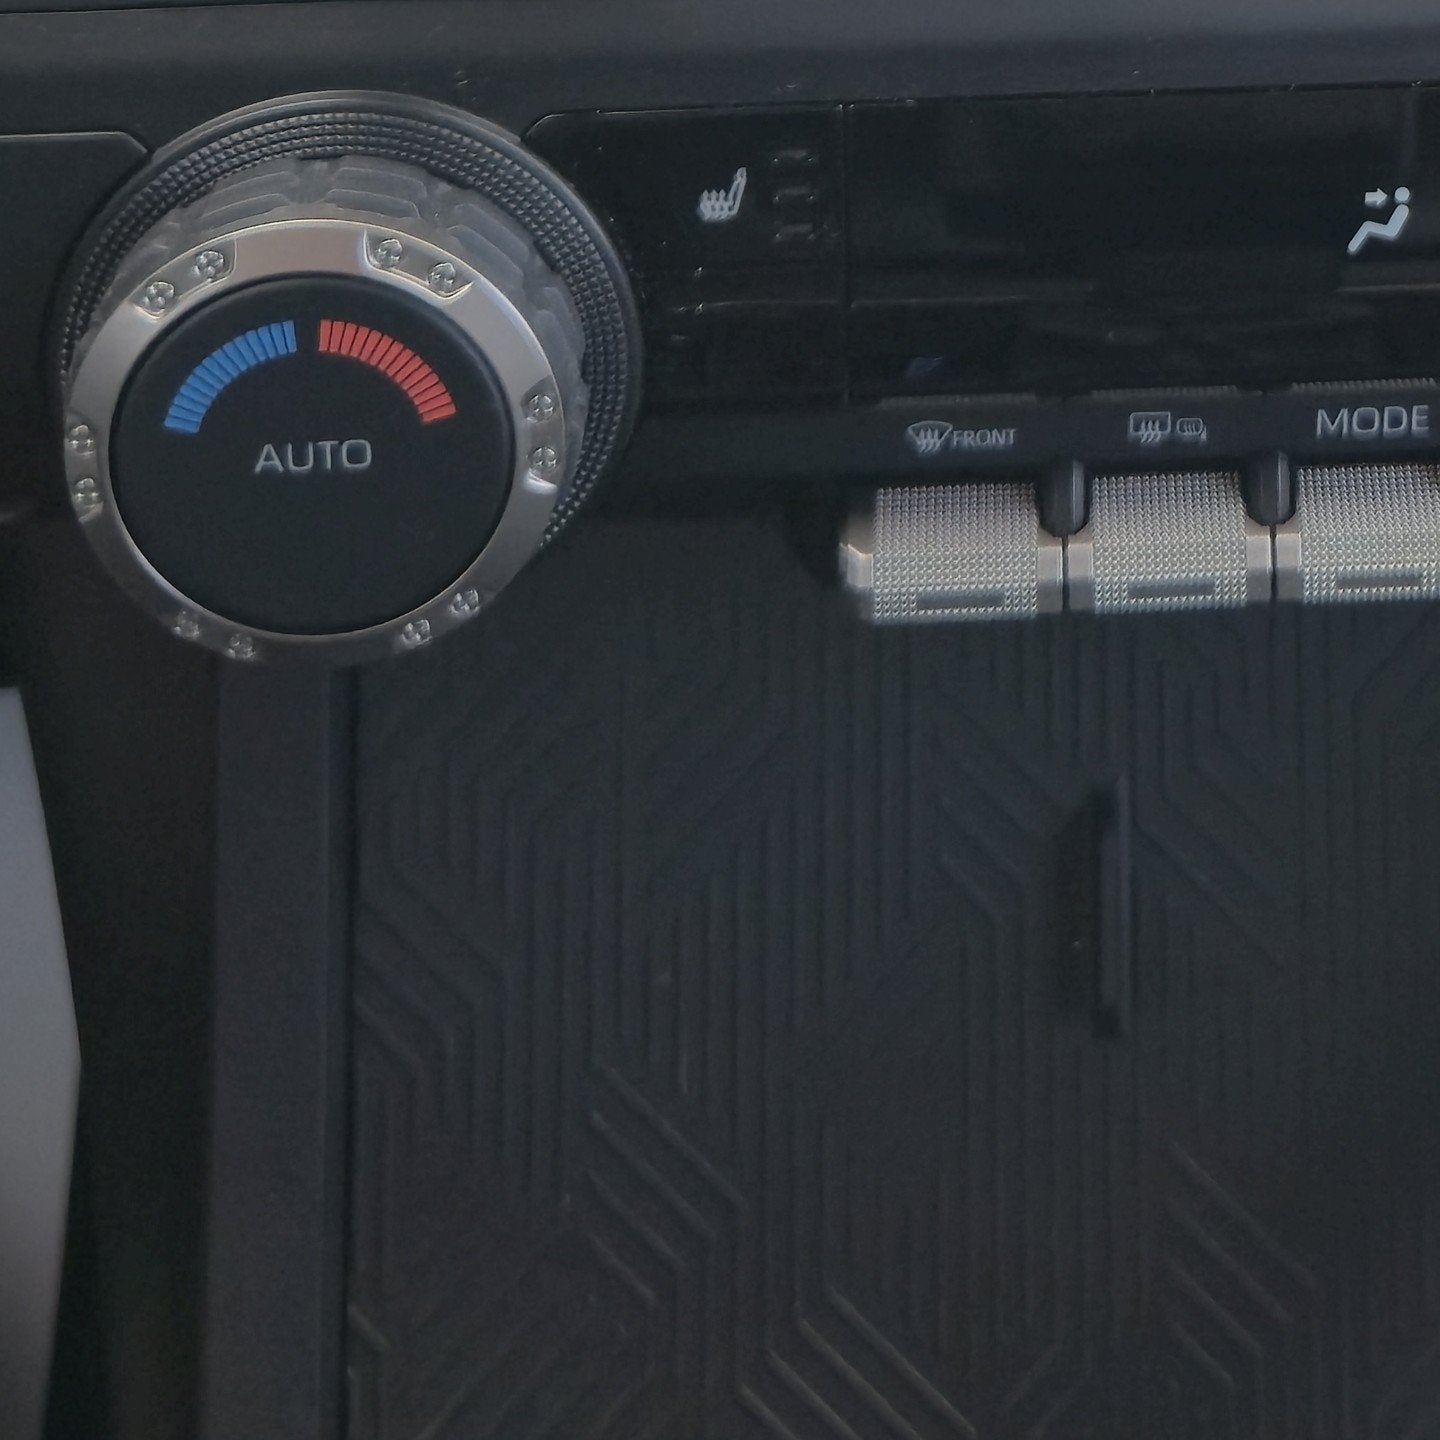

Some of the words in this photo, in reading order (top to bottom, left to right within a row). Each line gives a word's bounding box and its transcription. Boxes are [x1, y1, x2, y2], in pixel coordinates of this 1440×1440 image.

[951, 428, 1017, 446] FRONT
[1316, 405, 1430, 438] MODE
[254, 438, 373, 474] AUTO
